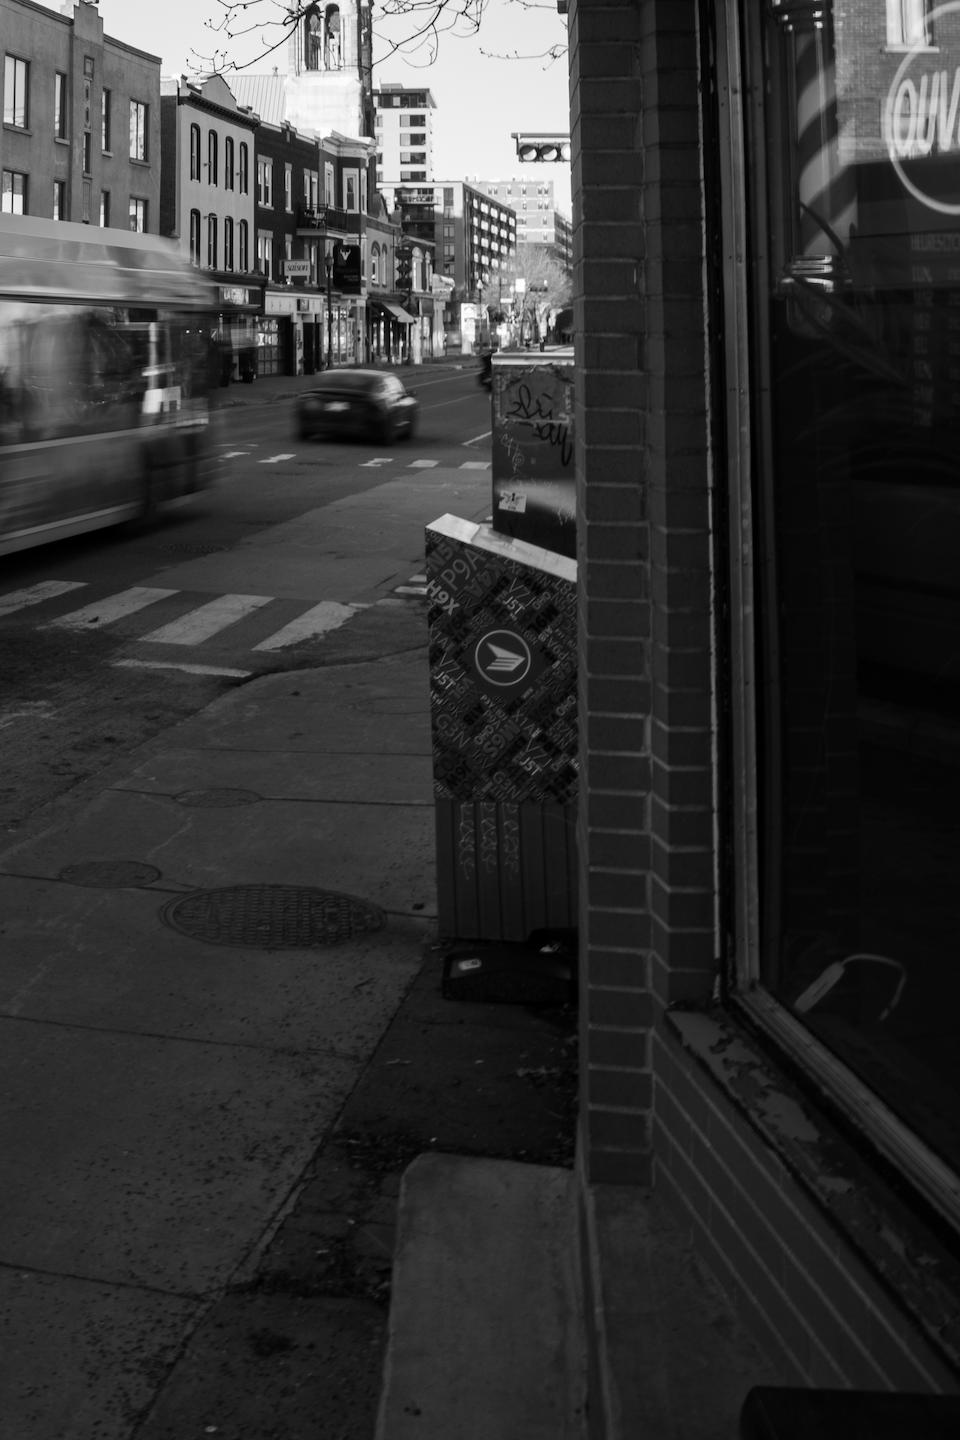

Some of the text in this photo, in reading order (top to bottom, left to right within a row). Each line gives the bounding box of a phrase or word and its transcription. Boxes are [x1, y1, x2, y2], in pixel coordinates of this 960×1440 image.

[893, 66, 960, 159] OUV
[440, 544, 485, 591] P9A
[424, 579, 460, 616] H9X
[503, 594, 525, 616] J5T
[433, 669, 455, 691] J5T
[434, 712, 471, 749] G3N
[519, 755, 542, 777] J5T
